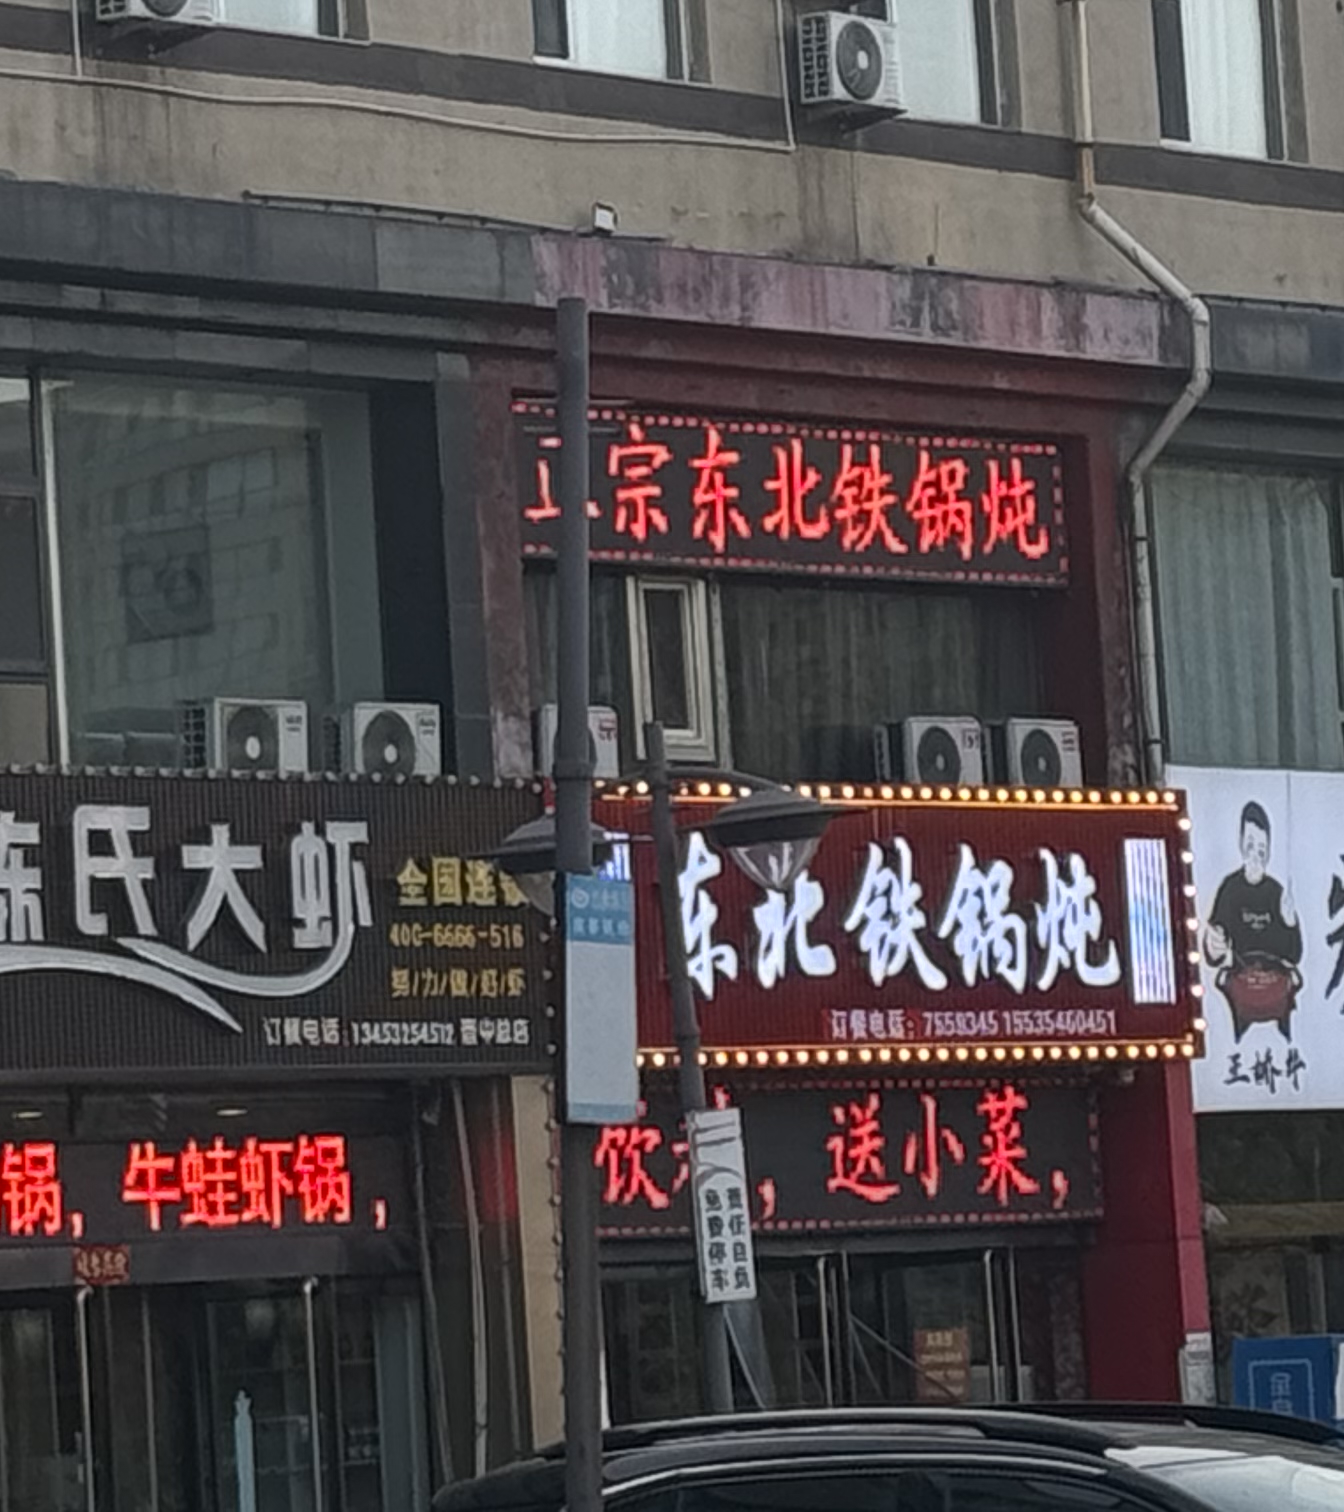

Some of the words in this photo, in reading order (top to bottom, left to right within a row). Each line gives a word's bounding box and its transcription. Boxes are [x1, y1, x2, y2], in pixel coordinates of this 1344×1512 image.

[678, 832, 1120, 999] 东北铁锅炖
